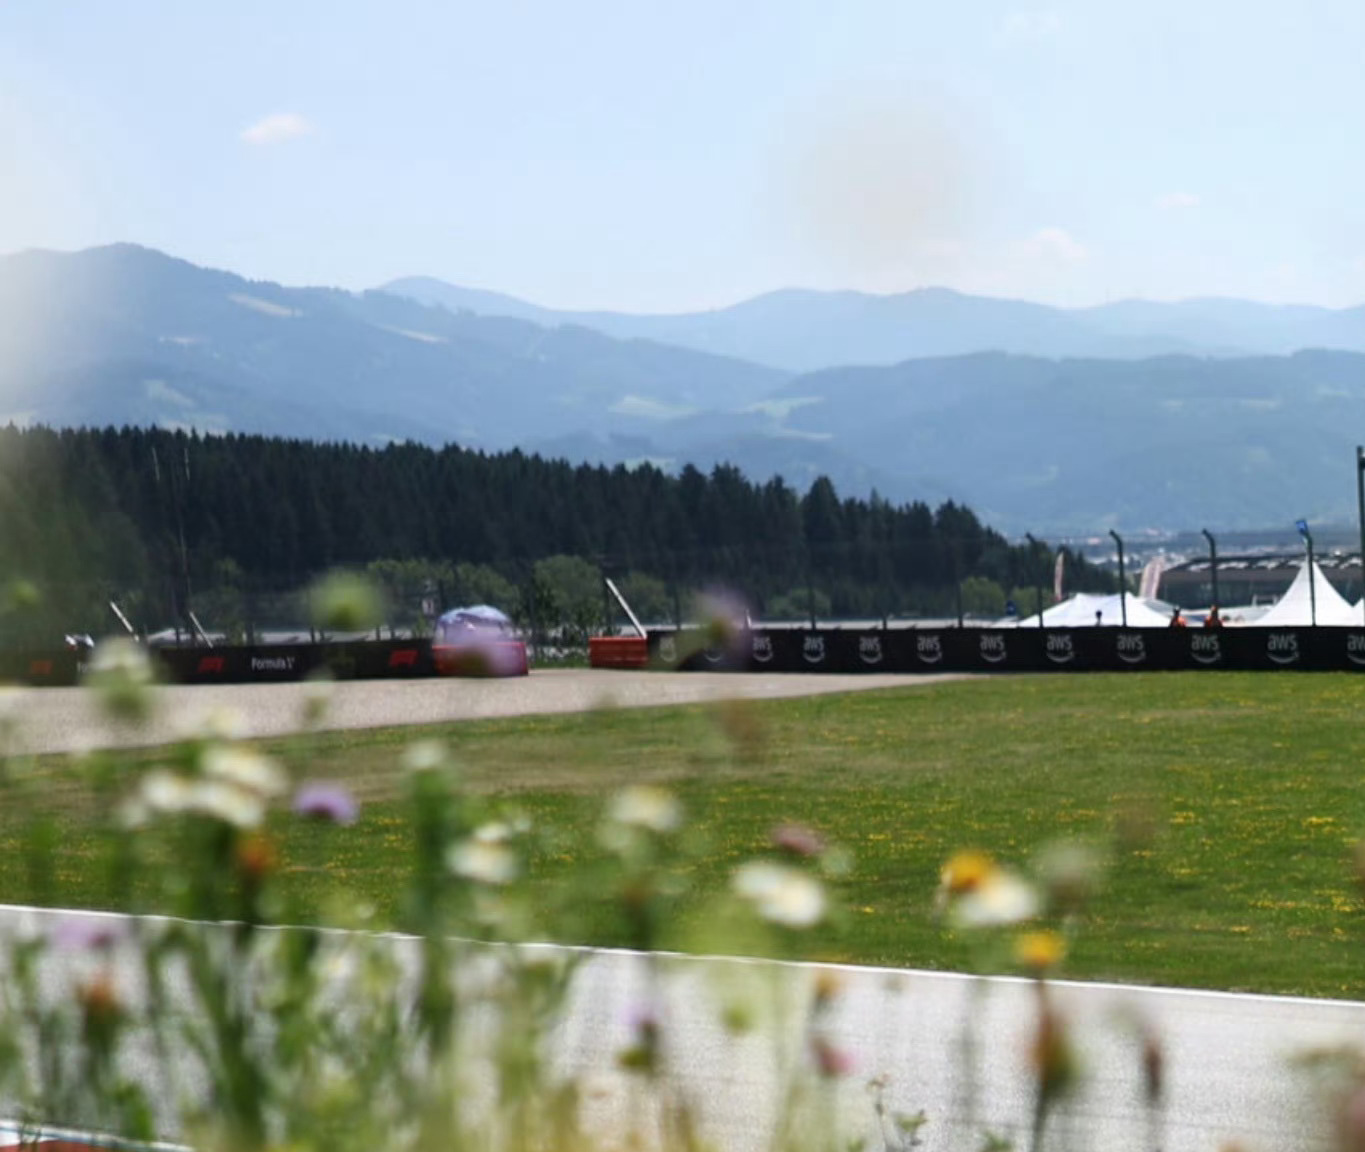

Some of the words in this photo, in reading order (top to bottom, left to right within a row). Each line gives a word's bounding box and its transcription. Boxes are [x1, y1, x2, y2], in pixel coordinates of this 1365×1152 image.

[981, 635, 1004, 651] aws
[1048, 636, 1072, 651] aws
[1118, 636, 1143, 651] aws
[1191, 636, 1218, 651] aws
[1268, 635, 1297, 651] aws
